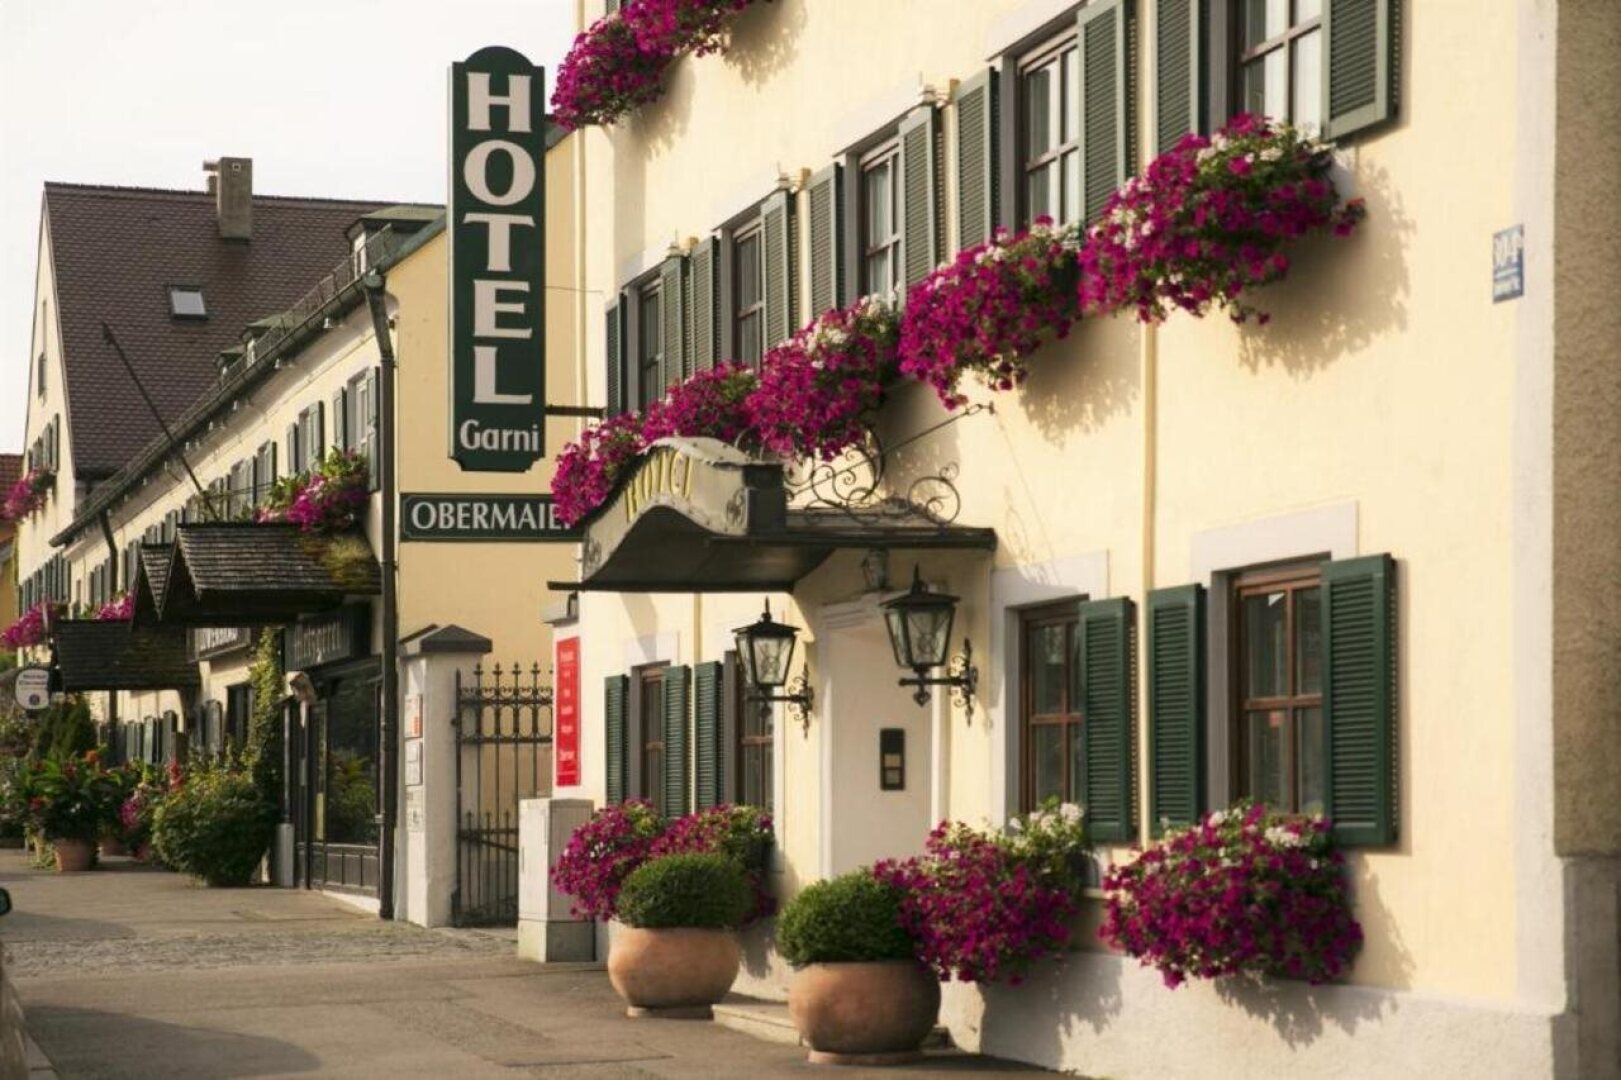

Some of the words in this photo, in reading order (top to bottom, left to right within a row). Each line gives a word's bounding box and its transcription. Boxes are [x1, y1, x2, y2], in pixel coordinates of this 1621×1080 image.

[463, 71, 536, 405] HOTEL
[460, 418, 540, 452] Garni
[411, 502, 571, 530] OBERMAIE
